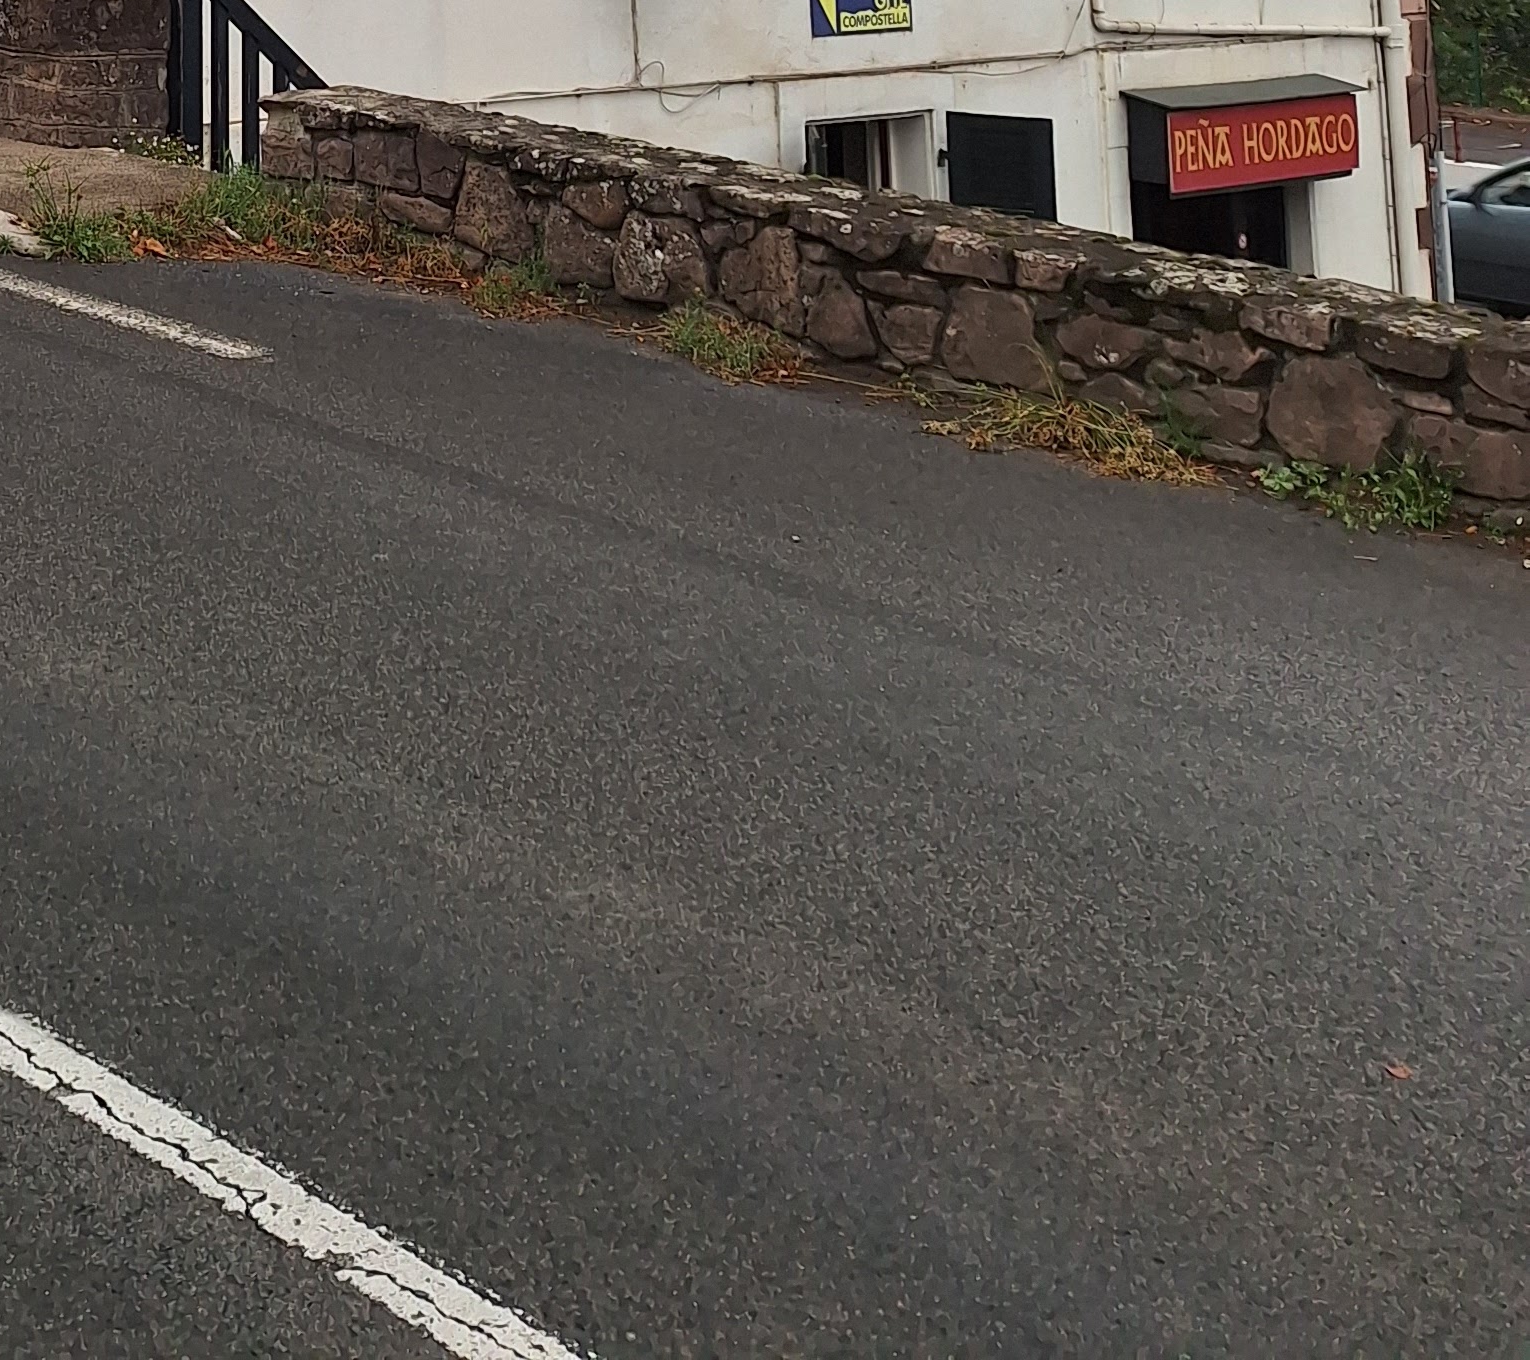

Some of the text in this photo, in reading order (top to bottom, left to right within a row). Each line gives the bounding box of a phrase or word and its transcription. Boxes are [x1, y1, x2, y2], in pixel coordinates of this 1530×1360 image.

[842, 12, 908, 28] COMPOSTELLA
[1173, 113, 1356, 174] PEÑA HORDAGO
